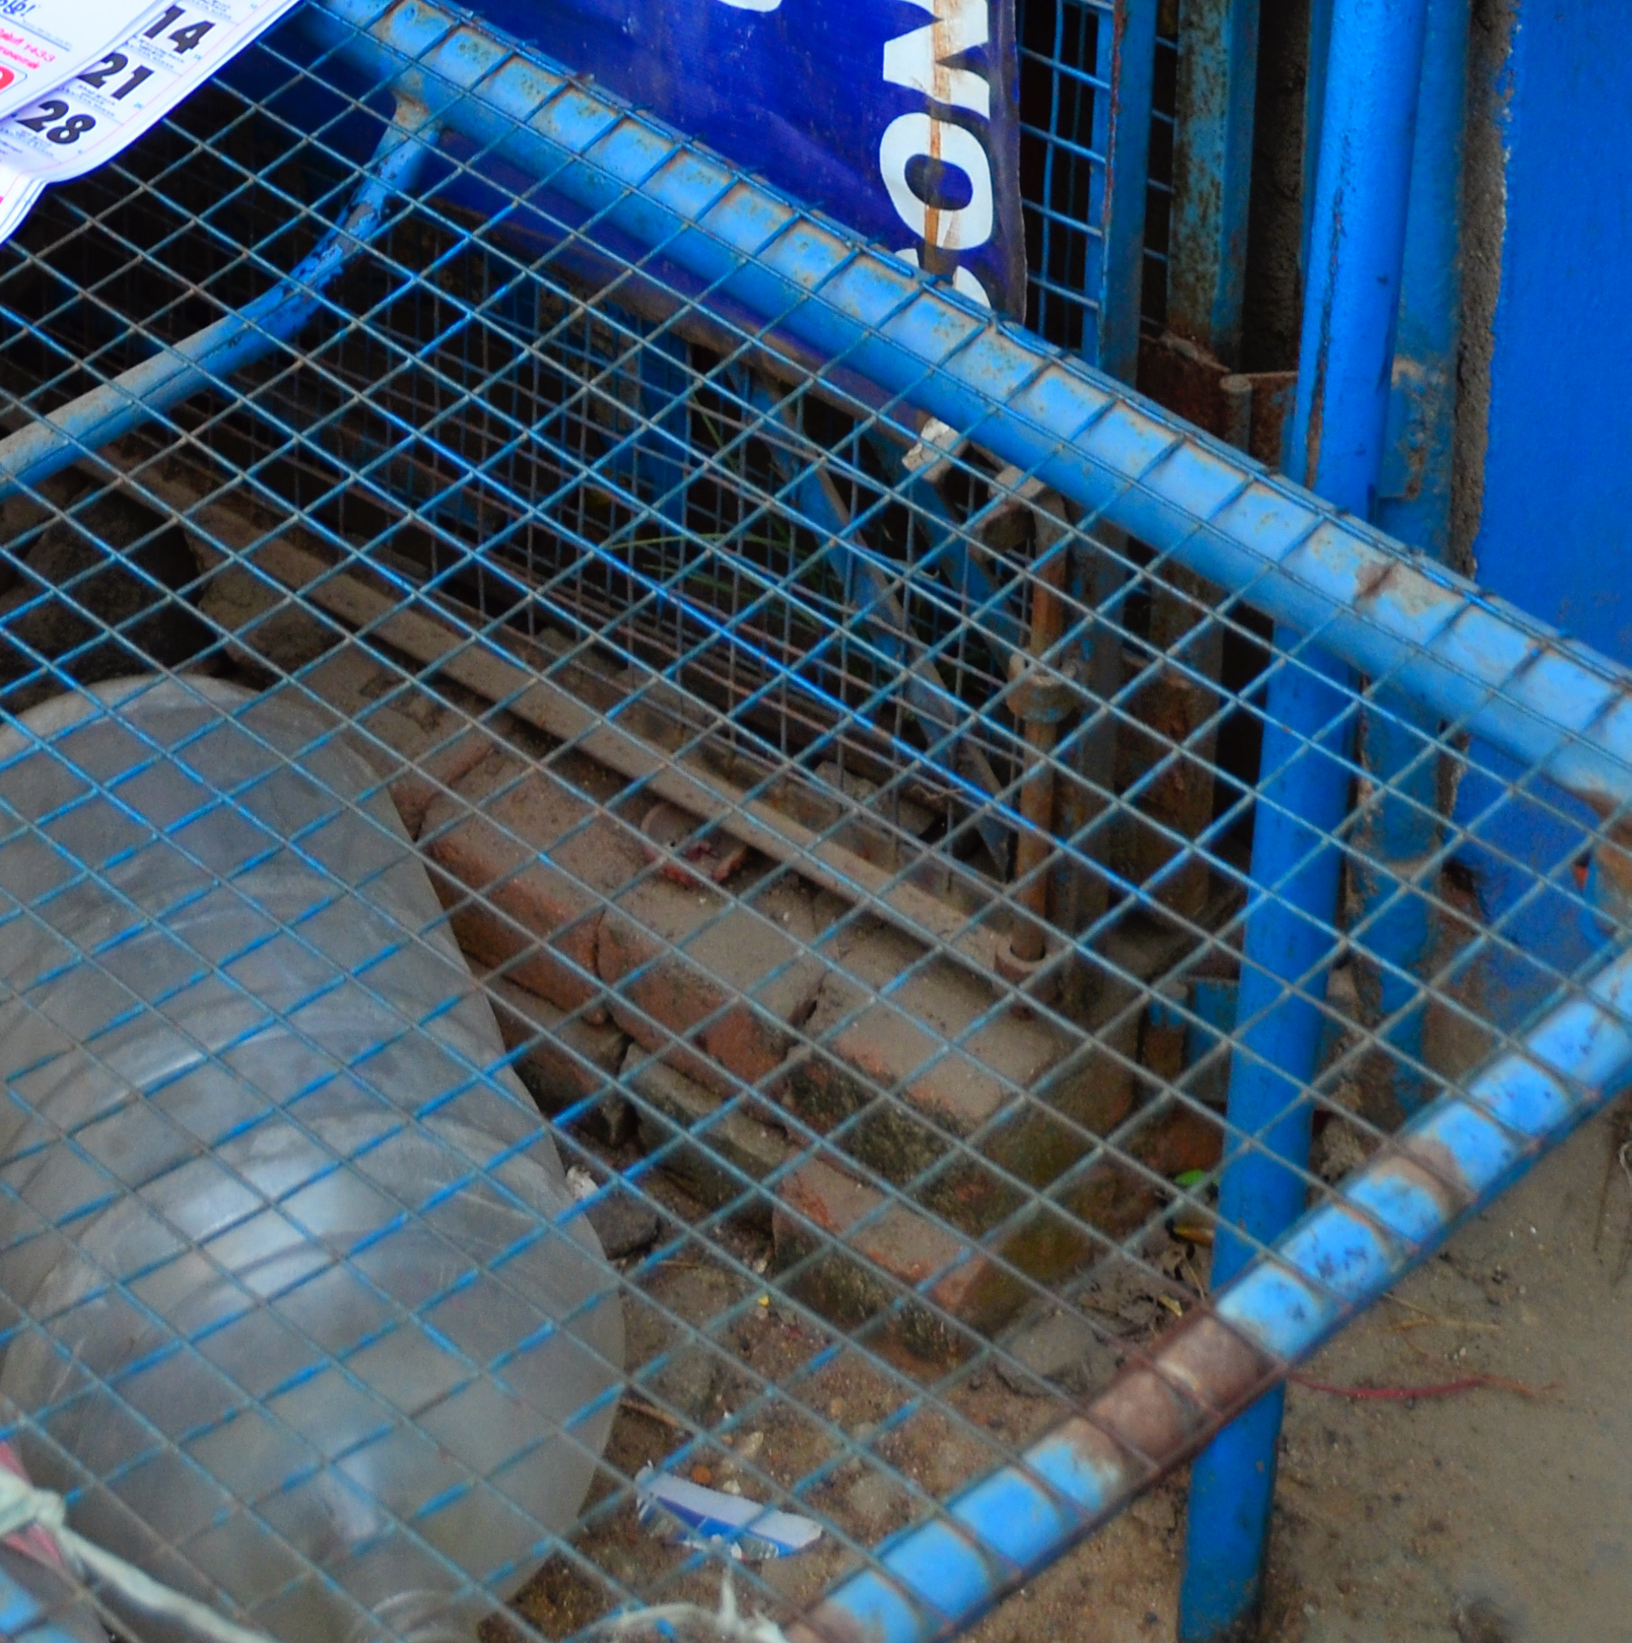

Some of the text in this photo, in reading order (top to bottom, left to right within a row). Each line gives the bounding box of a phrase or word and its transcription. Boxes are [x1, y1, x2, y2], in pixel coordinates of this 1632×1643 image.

[147, 5, 218, 55] 14
[81, 51, 156, 102] 21
[16, 99, 97, 146] 28
